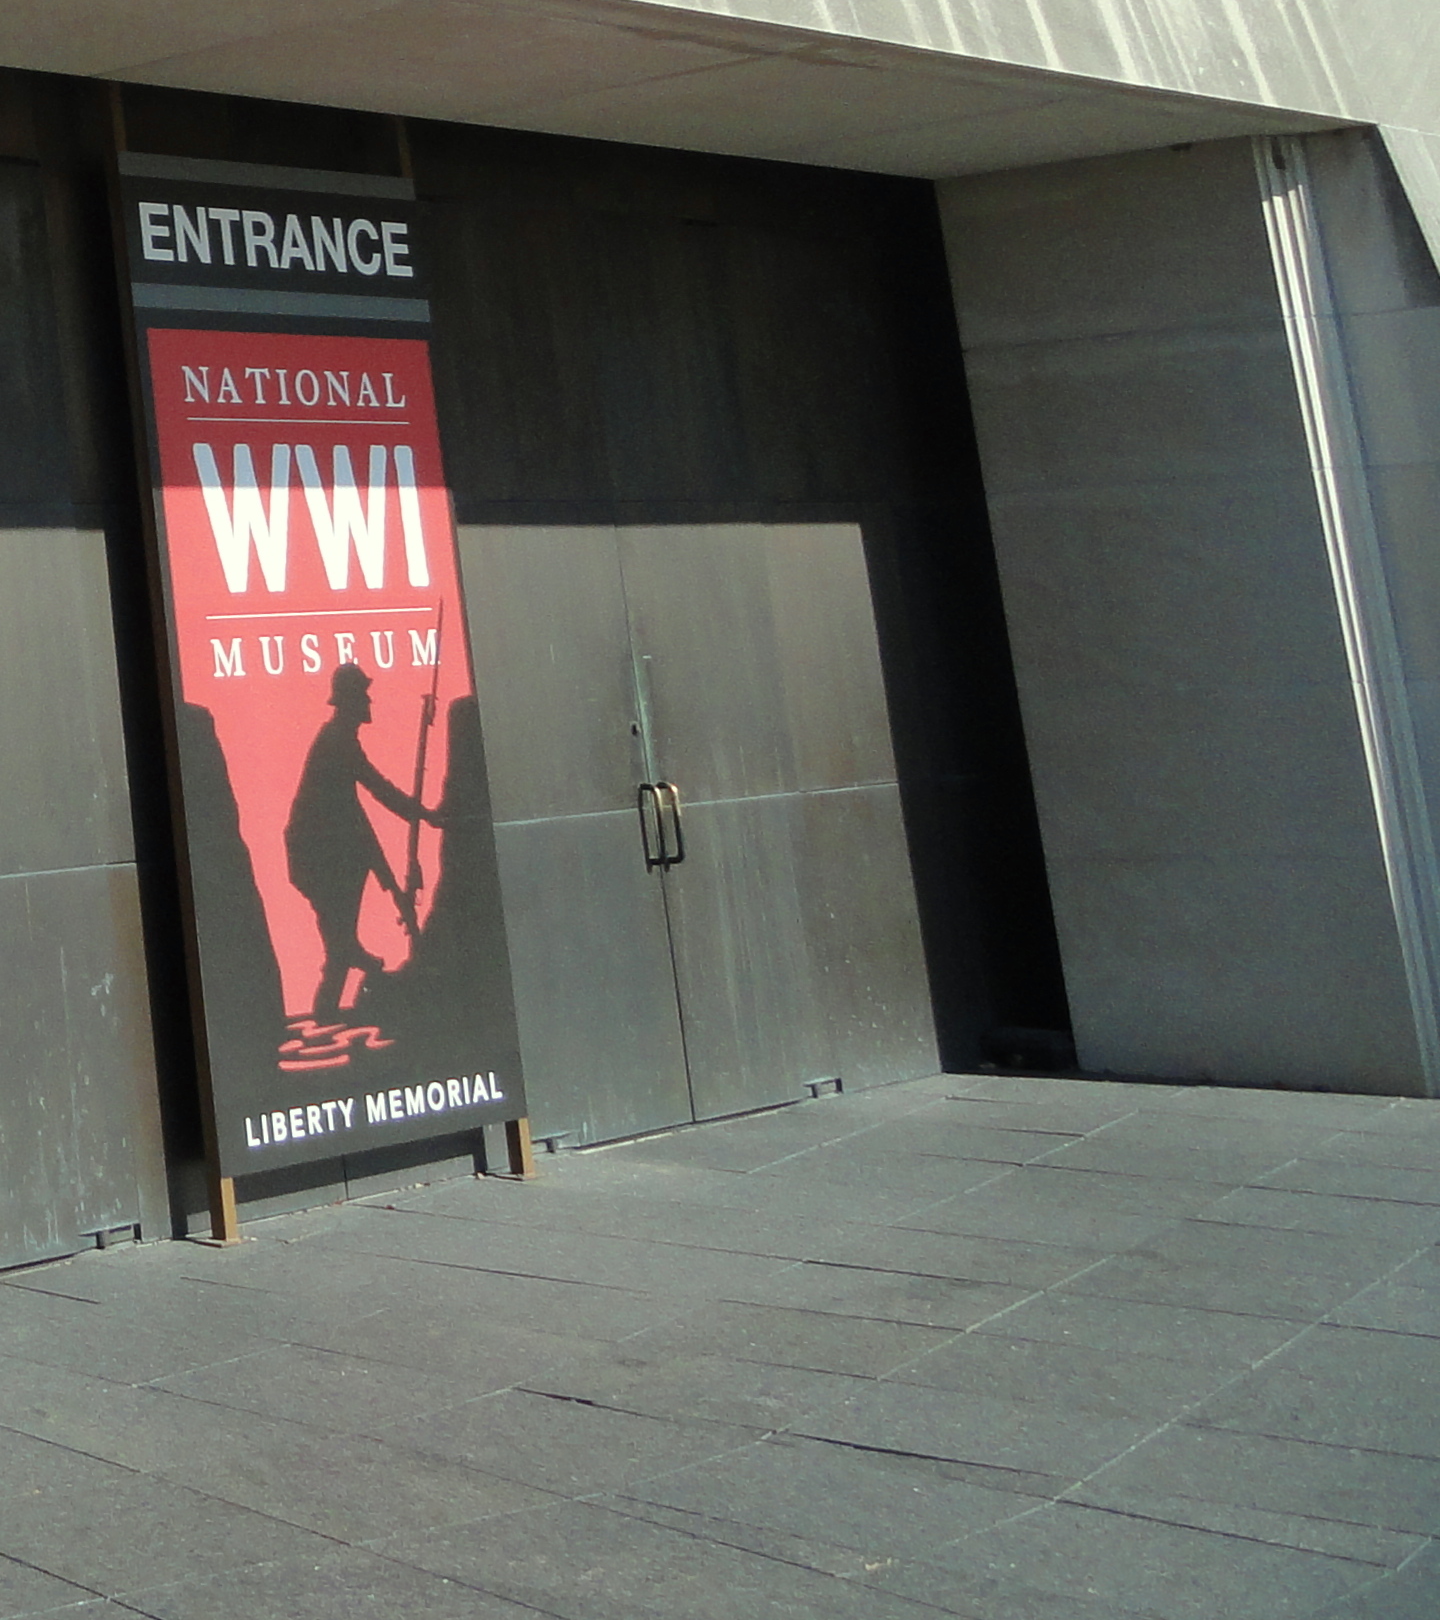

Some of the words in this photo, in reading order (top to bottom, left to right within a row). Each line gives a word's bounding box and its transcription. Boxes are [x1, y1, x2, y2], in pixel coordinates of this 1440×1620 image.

[137, 201, 414, 278] ENTRANCE
[180, 365, 407, 409] NATIONAL
[192, 442, 431, 594] WWI
[209, 628, 441, 678] MUSEUM
[244, 1097, 355, 1148] LIBERTY
[364, 1071, 505, 1124] MEMORIAL
